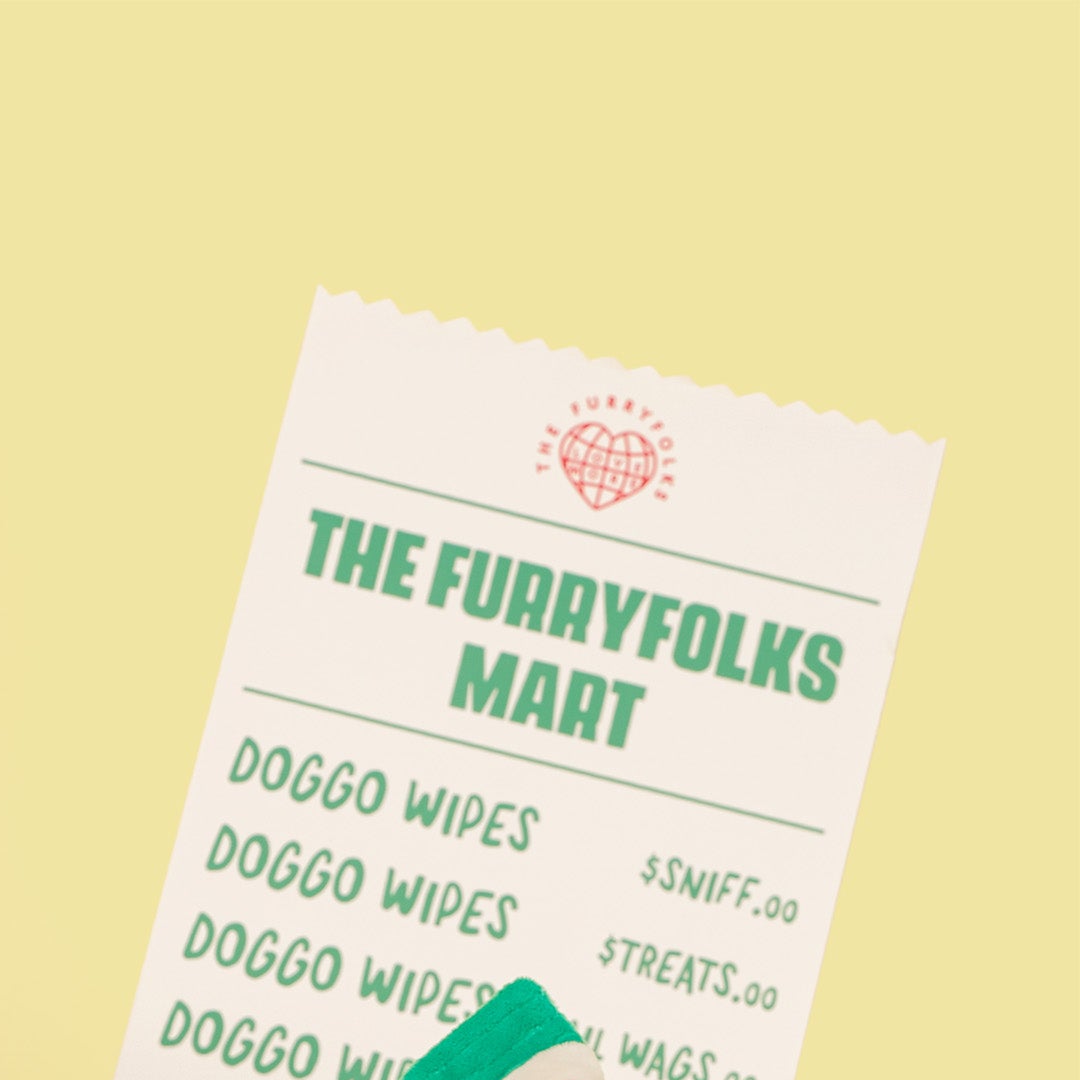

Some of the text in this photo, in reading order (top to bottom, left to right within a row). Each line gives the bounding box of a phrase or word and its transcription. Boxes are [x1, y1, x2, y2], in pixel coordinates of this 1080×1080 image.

[536, 395, 675, 500] THE FURRYFOLKS
[306, 510, 843, 701] THE FURRYFOLKS
[451, 644, 645, 747] MART
[230, 738, 538, 850] DOGGO WIPES
[207, 825, 517, 938] DOGGO WIPES
[184, 914, 341, 990] DOGGO
[161, 1002, 319, 1078] DOGGO
